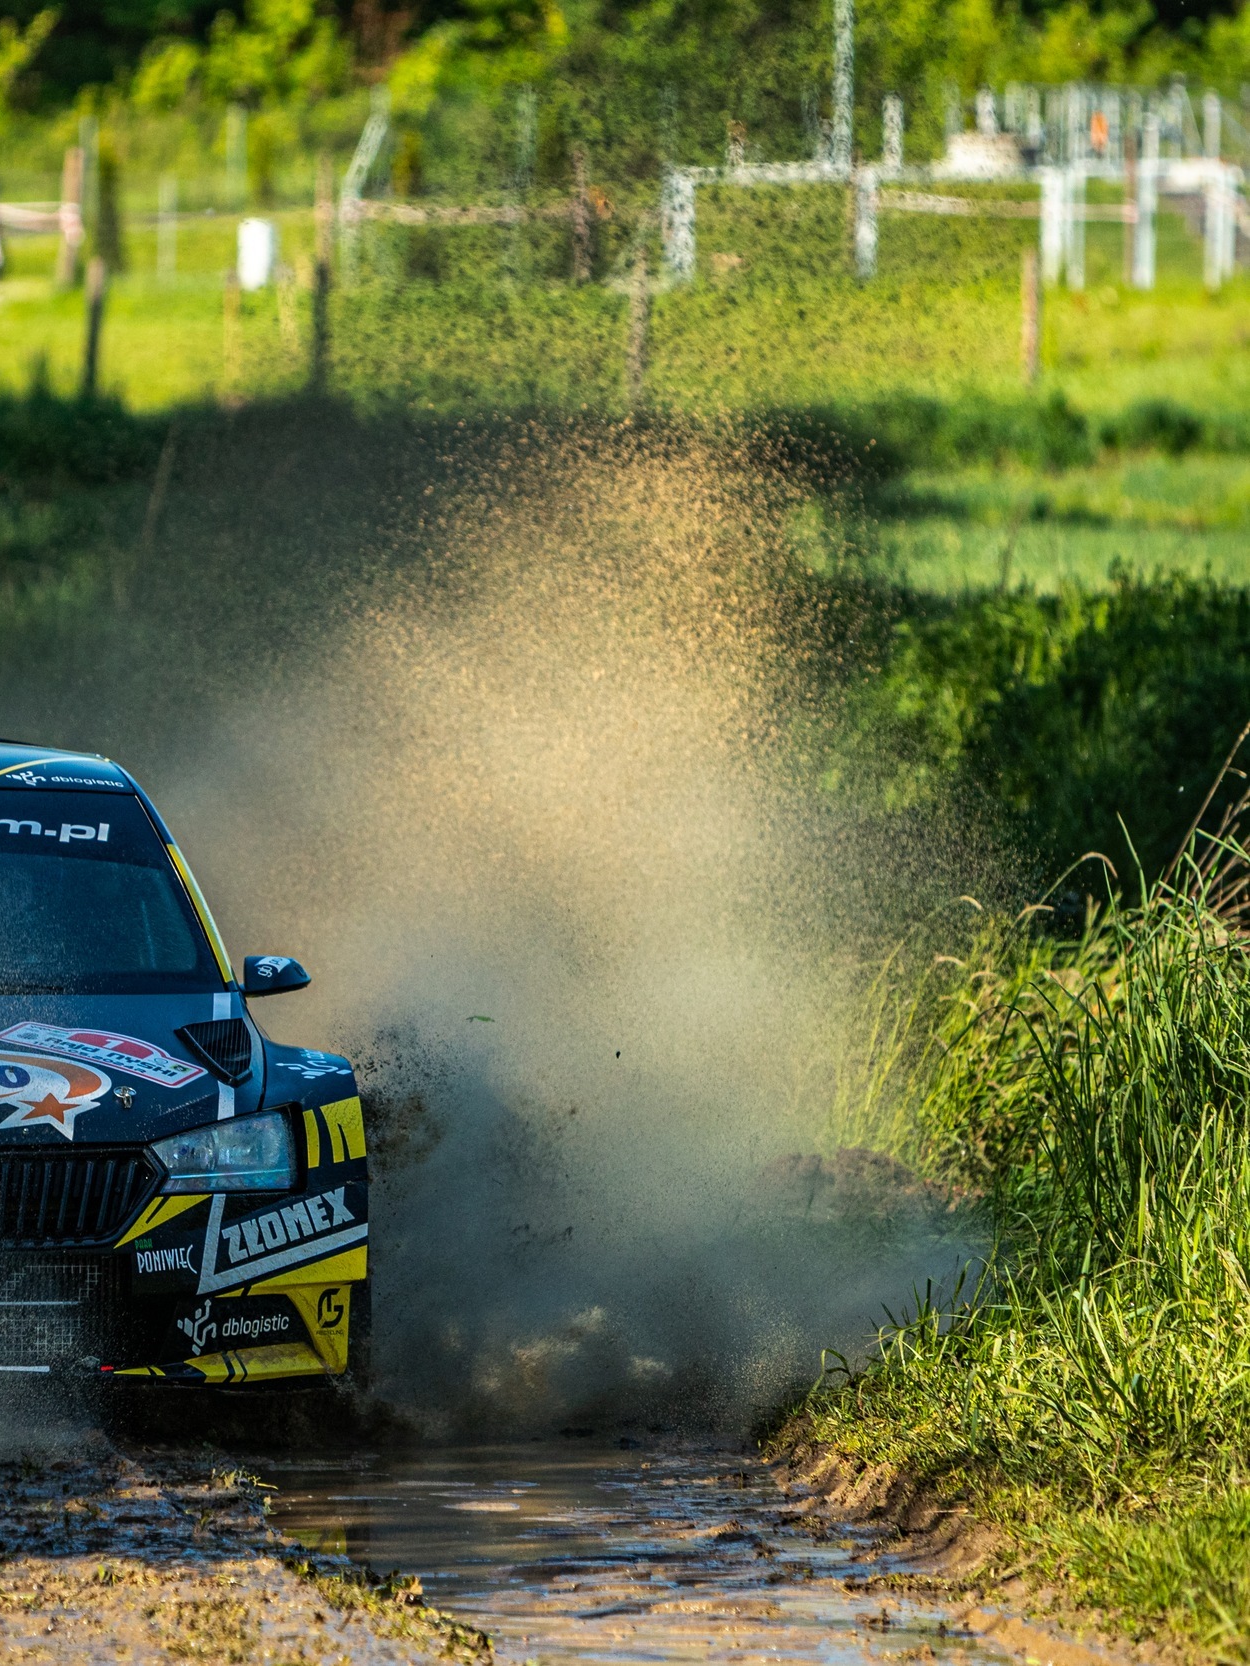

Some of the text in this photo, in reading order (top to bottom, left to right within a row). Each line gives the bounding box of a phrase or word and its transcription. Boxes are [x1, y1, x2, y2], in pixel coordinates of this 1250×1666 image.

[51, 775, 124, 788] dblogistic
[102, 1039, 125, 1050] 1
[136, 1244, 198, 1274] PONIWIEC
[222, 1313, 290, 1338] dblogistic
